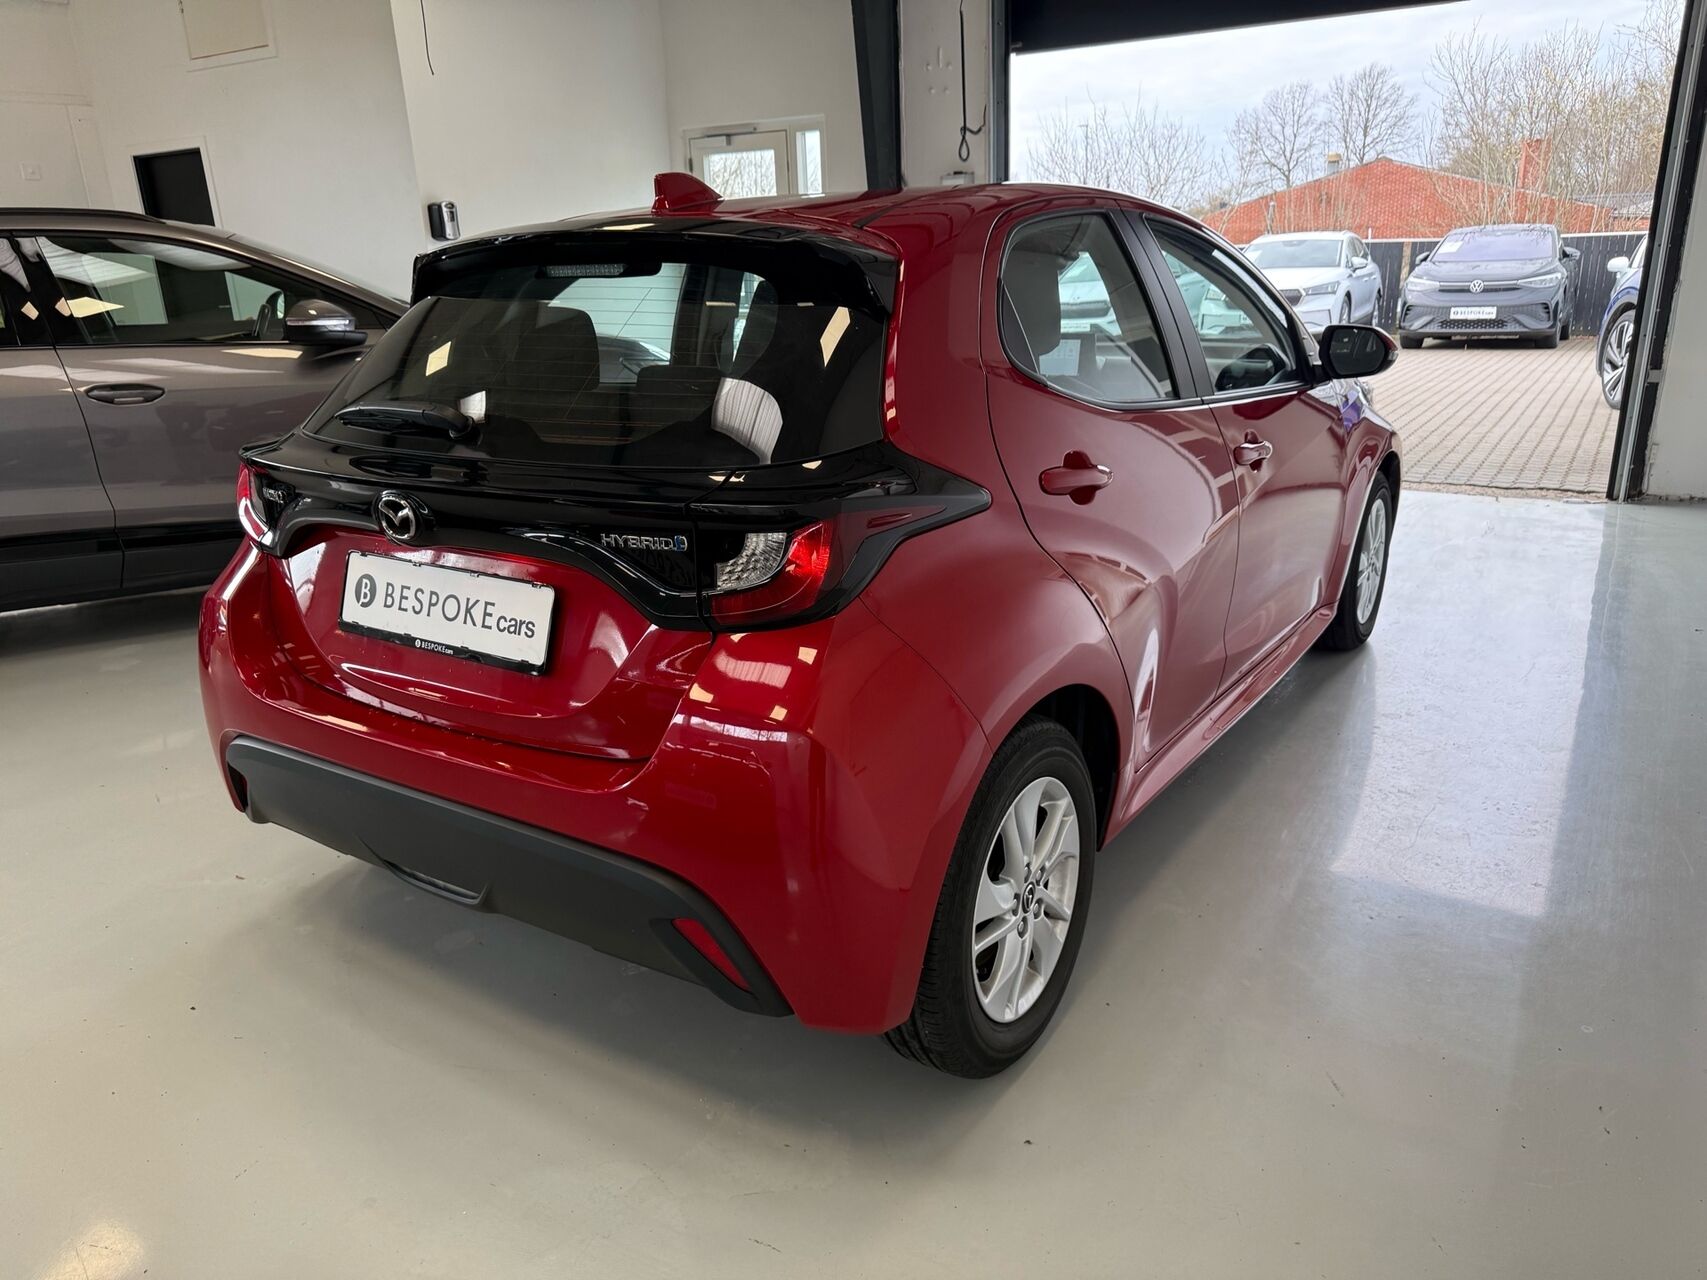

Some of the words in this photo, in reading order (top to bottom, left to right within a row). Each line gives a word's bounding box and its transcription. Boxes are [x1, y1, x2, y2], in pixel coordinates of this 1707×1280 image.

[600, 533, 674, 551] HYBRID
[383, 581, 496, 631] BESPOKE
[496, 614, 536, 639] cars
[421, 640, 446, 653] BESPOKE
